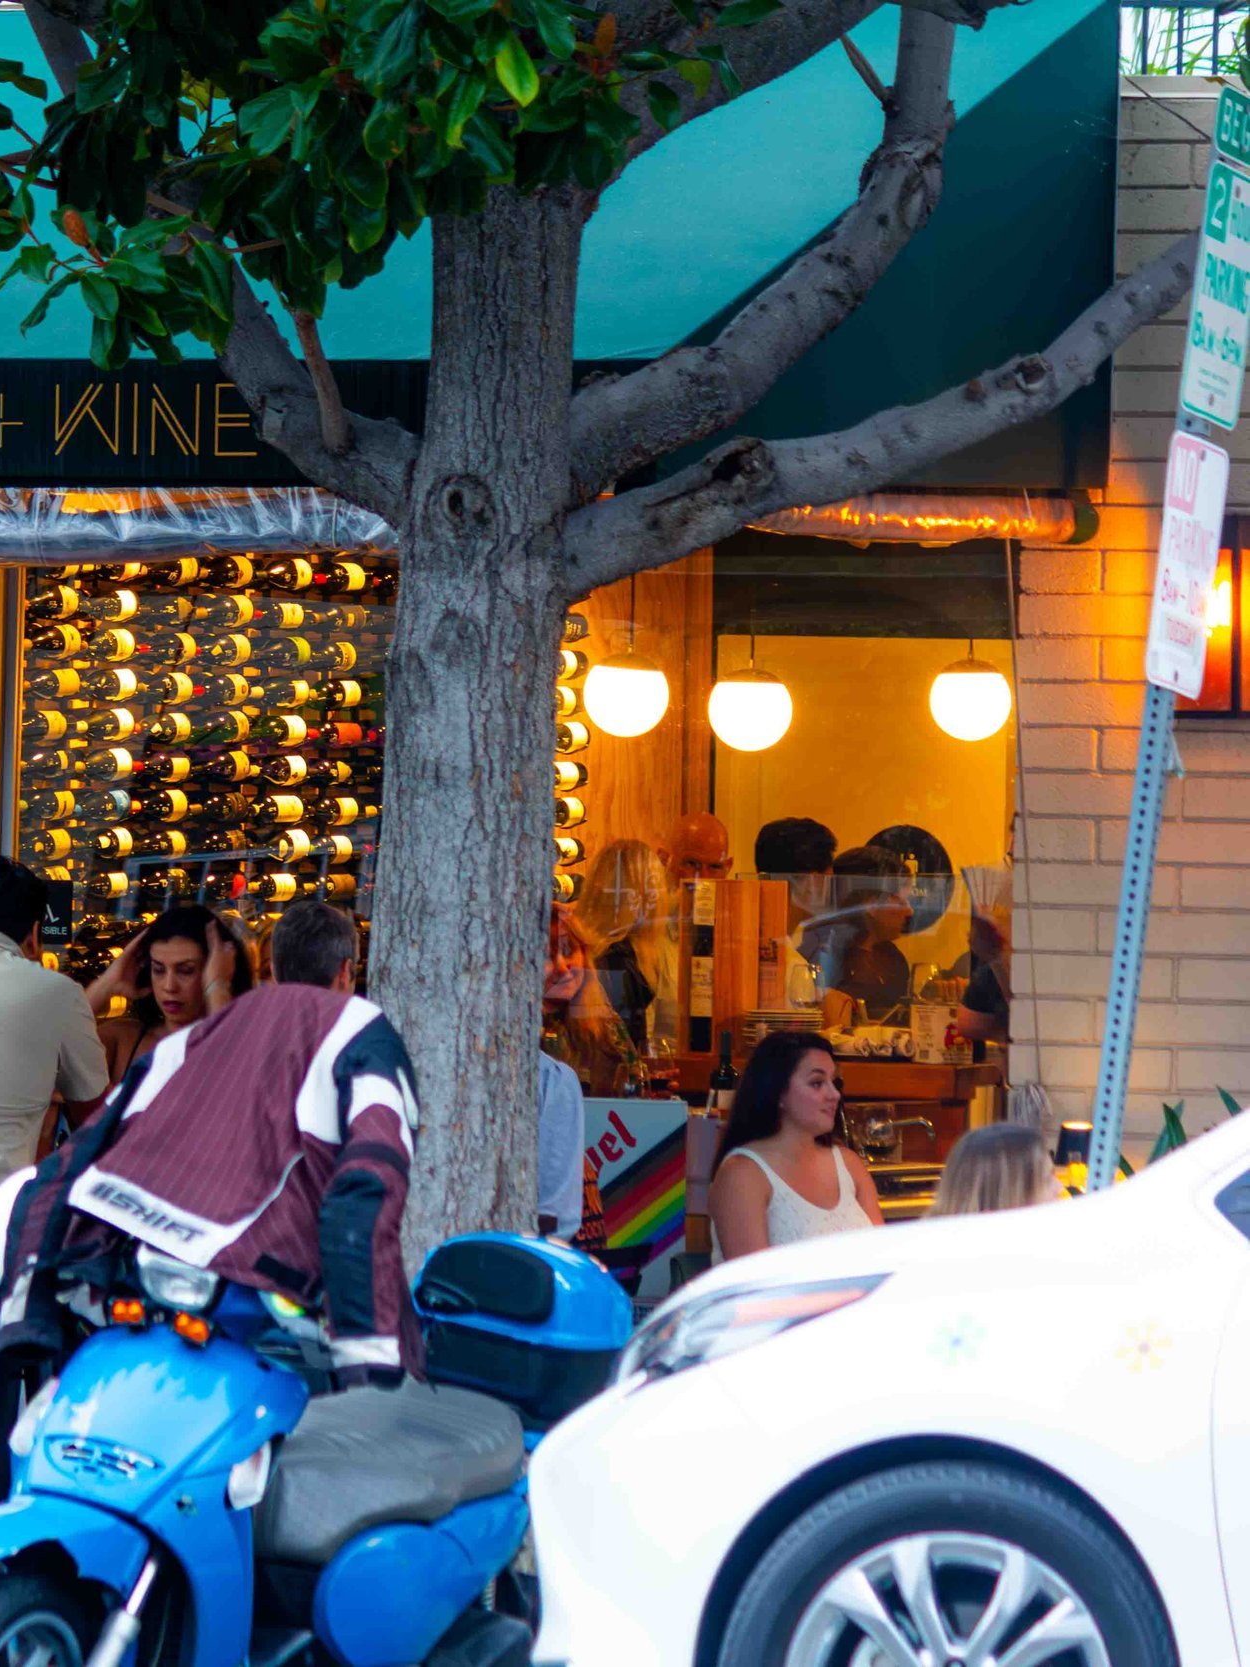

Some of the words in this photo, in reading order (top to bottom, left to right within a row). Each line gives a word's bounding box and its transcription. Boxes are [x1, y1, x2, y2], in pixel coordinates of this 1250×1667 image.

[1210, 177, 1226, 230] 2
[54, 383, 258, 456] WINE
[1172, 447, 1197, 504] NO
